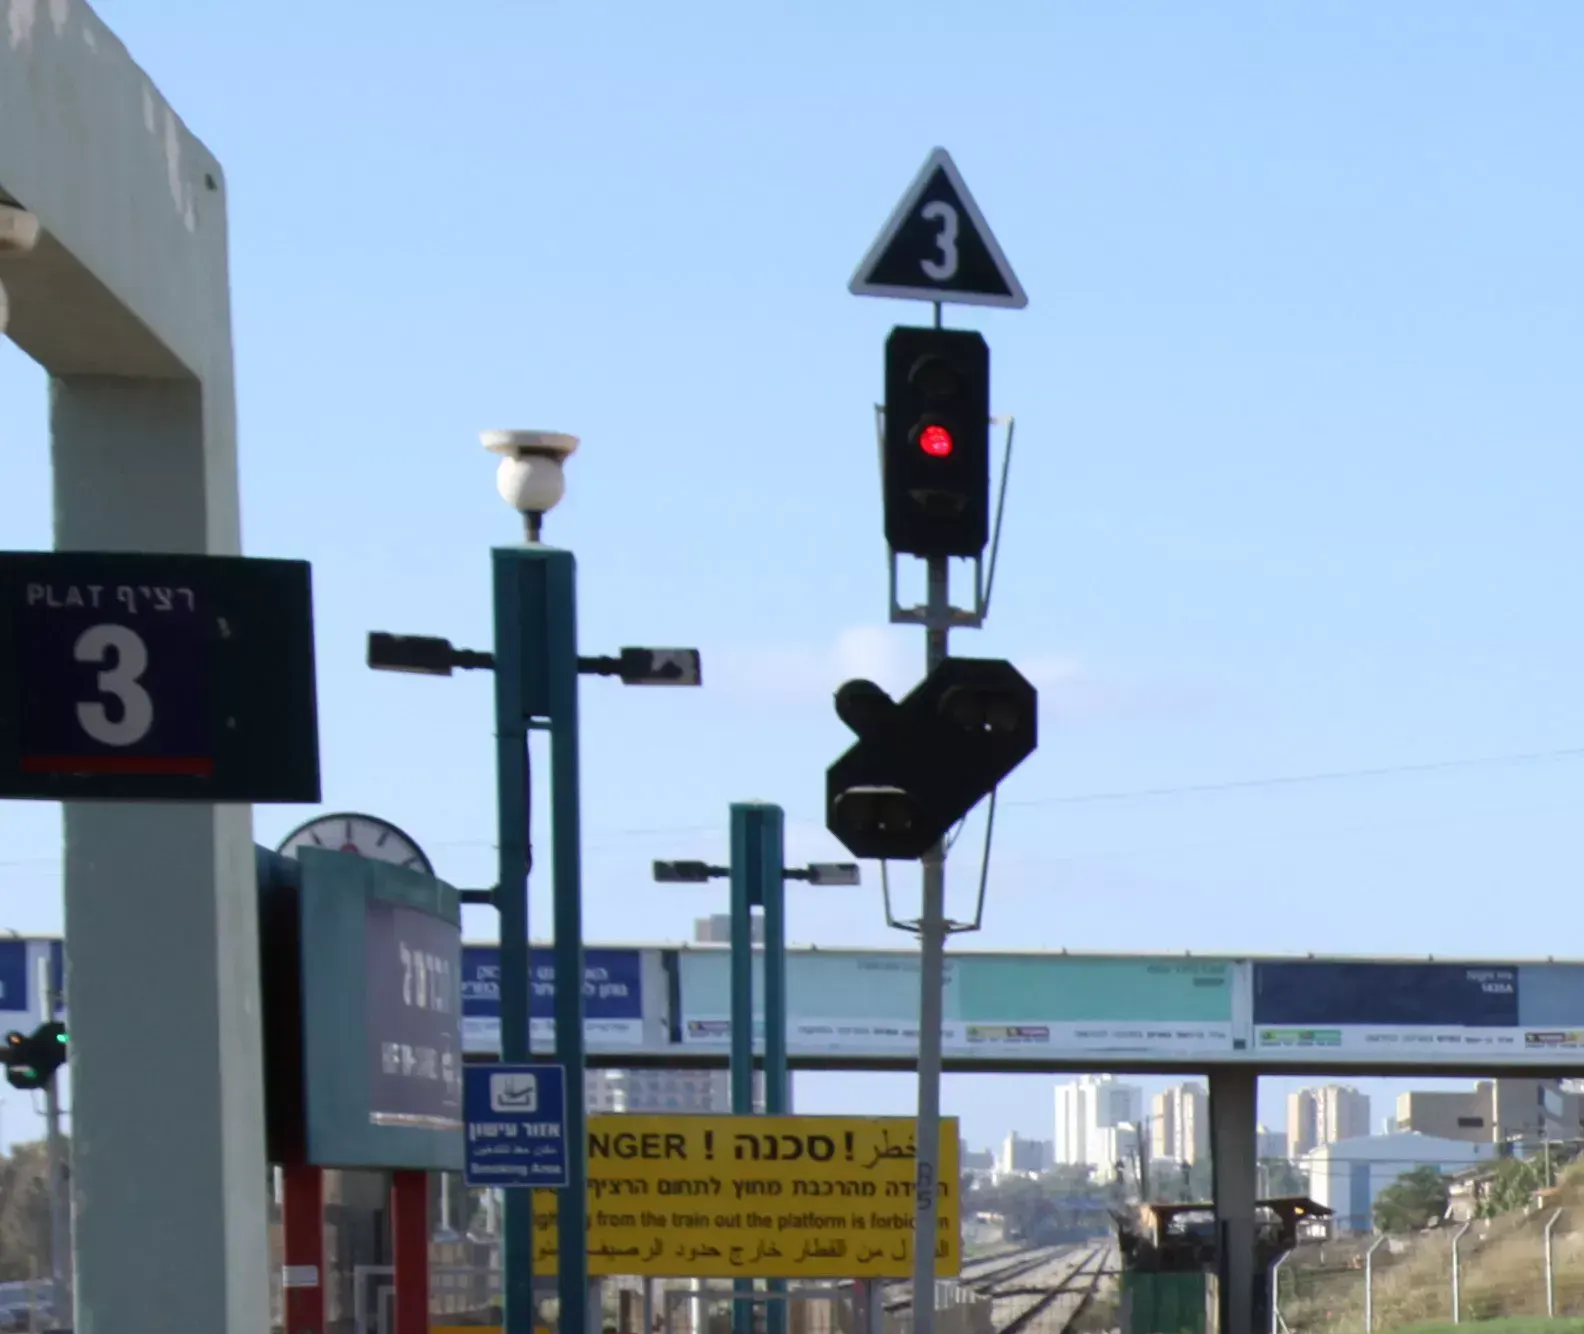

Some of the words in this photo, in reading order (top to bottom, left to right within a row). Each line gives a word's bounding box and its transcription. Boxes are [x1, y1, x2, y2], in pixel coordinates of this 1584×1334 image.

[919, 200, 959, 281] 3
[26, 582, 105, 609] PLAT
[116, 584, 195, 614] רציף
[73, 622, 154, 747] 3
[469, 1122, 518, 1142] עישון
[521, 1122, 561, 1137] אזור
[588, 1132, 687, 1160] NGER
[734, 1133, 836, 1162] סכנה
[588, 1178, 649, 1198] הרציף
[657, 1176, 722, 1195] לתחום
[732, 1178, 783, 1200] מחוץ
[792, 1178, 877, 1197] מהרכבת
[597, 1210, 636, 1227] from
[641, 1210, 667, 1228] the
[672, 1212, 710, 1228] train
[714, 1213, 741, 1228] out
[746, 1212, 773, 1229] the
[777, 1212, 846, 1232] platform
[852, 1214, 866, 1230] is
